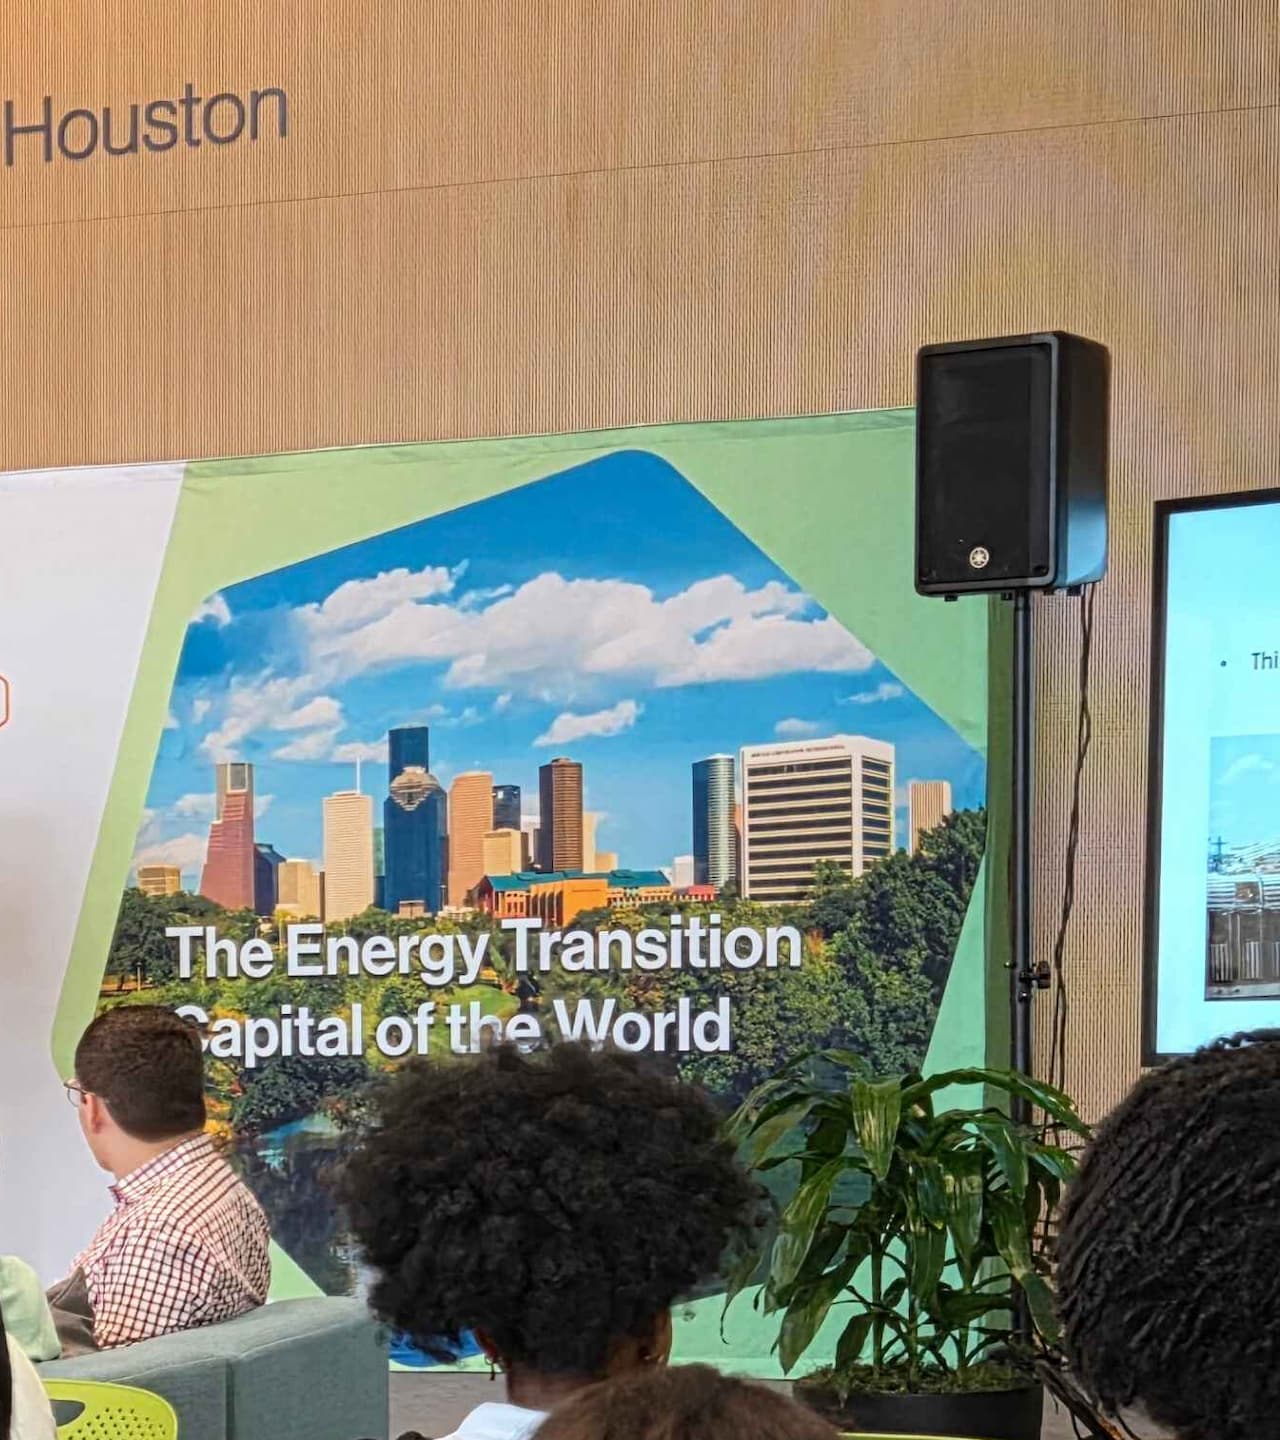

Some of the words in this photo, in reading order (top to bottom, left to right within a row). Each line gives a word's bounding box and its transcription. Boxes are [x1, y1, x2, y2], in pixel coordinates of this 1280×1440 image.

[3, 83, 288, 167] Houston
[165, 924, 275, 979] The
[286, 923, 490, 986] Energy
[500, 913, 803, 972] Transition
[375, 1002, 435, 1057] of
[445, 1001, 541, 1055] the
[552, 996, 732, 1053] World
